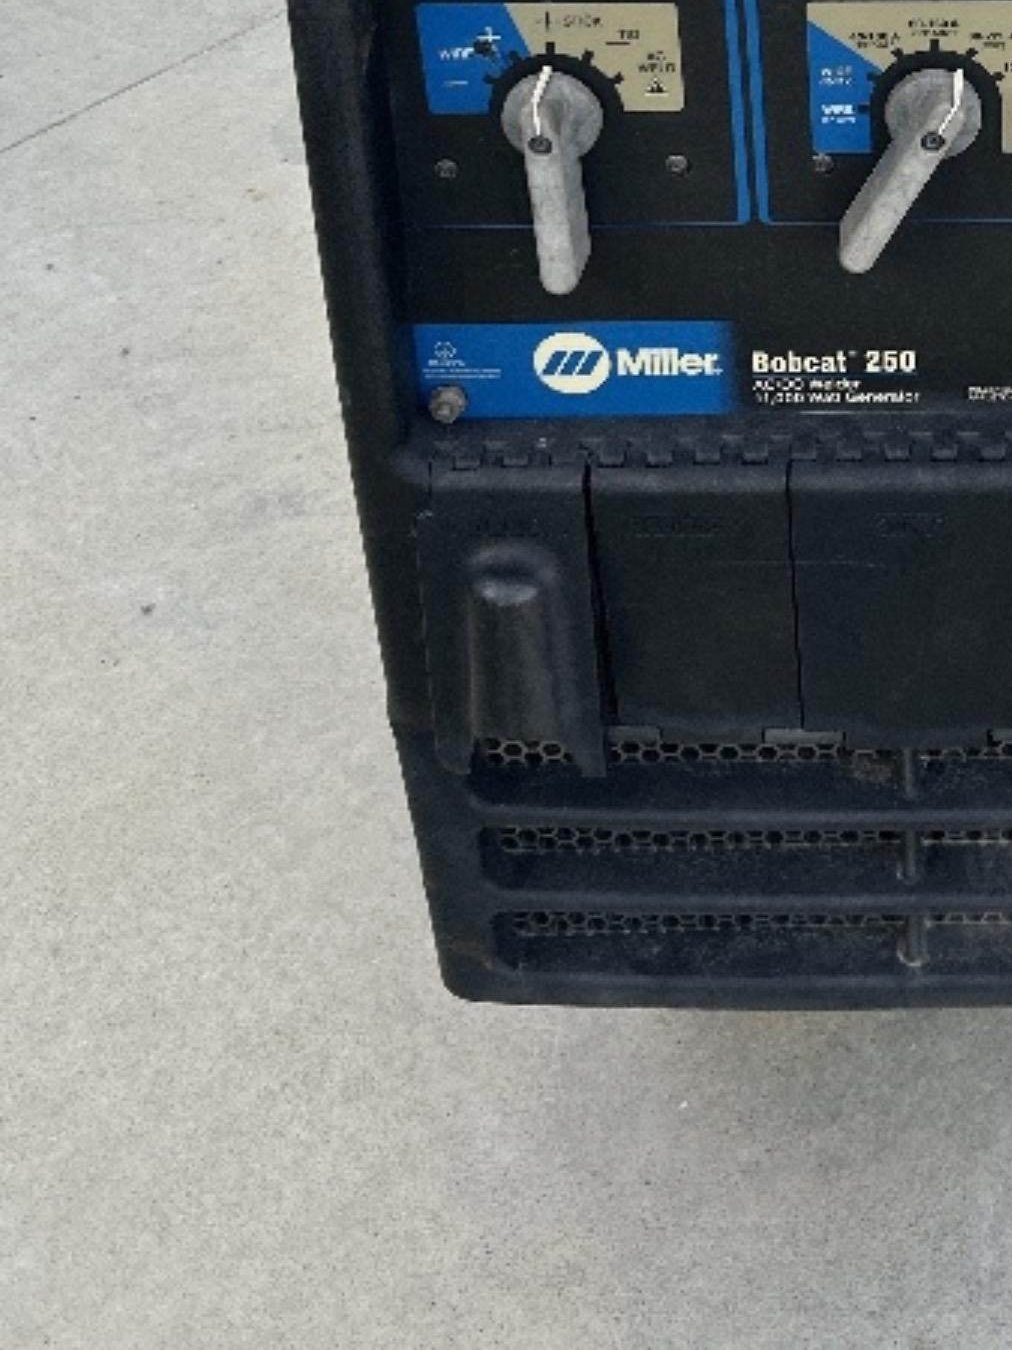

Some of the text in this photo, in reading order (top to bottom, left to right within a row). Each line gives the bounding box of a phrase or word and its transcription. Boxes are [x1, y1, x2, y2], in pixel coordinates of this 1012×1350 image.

[616, 348, 718, 376] Miller
[752, 350, 917, 373] Bobcat 250
[845, 390, 921, 403] Generator
